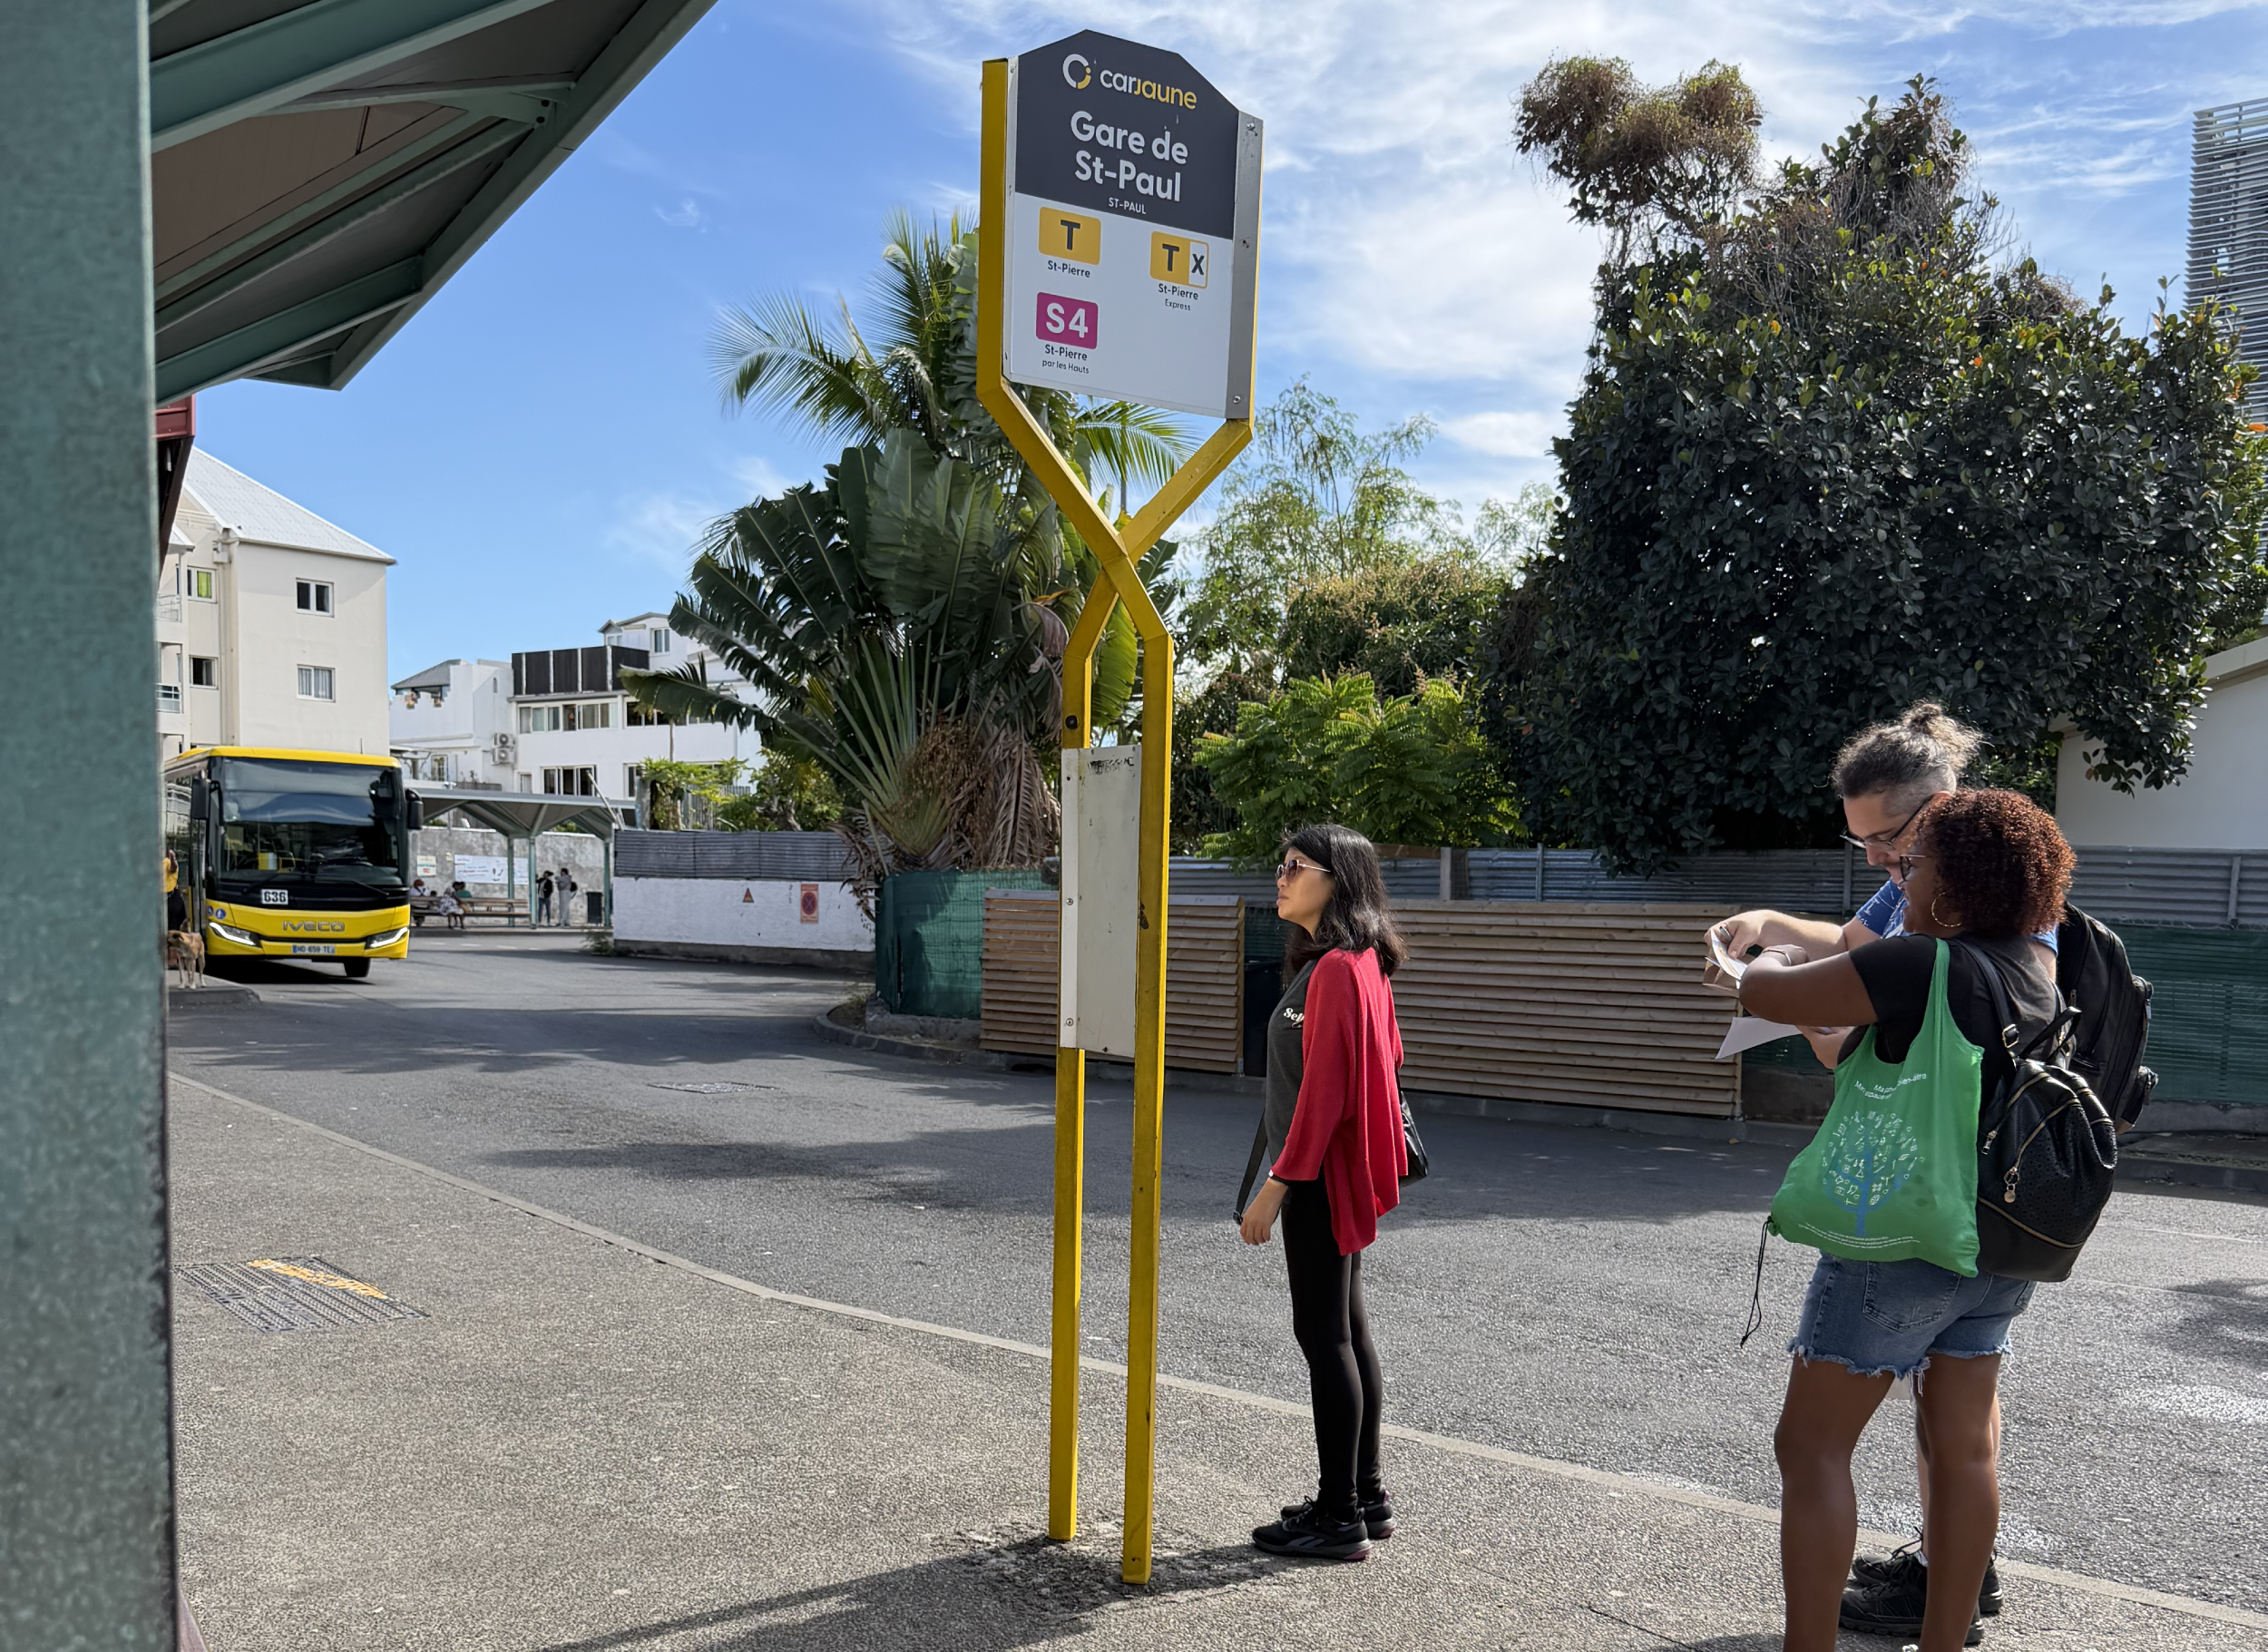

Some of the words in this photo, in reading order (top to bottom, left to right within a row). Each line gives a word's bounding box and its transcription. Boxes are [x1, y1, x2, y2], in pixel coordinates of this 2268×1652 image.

[1100, 68, 1198, 110] carjaune
[1070, 111, 1146, 154] Gare
[1151, 130, 1188, 164] de
[1075, 150, 1181, 202] St-Paul
[1109, 197, 1147, 215] ST-PAUL
[1060, 219, 1081, 251] T
[1047, 259, 1090, 279] St-Pierre
[1158, 283, 1199, 300] St-Pierre
[1165, 298, 1191, 311] Express
[1045, 302, 1089, 338] S4
[1044, 344, 1088, 361] St-Pierre
[1041, 359, 1055, 369] par
[1056, 360, 1067, 370] les
[1068, 363, 1090, 375] Hauts
[264, 891, 287, 903] 636
[282, 921, 345, 933] IVECO
